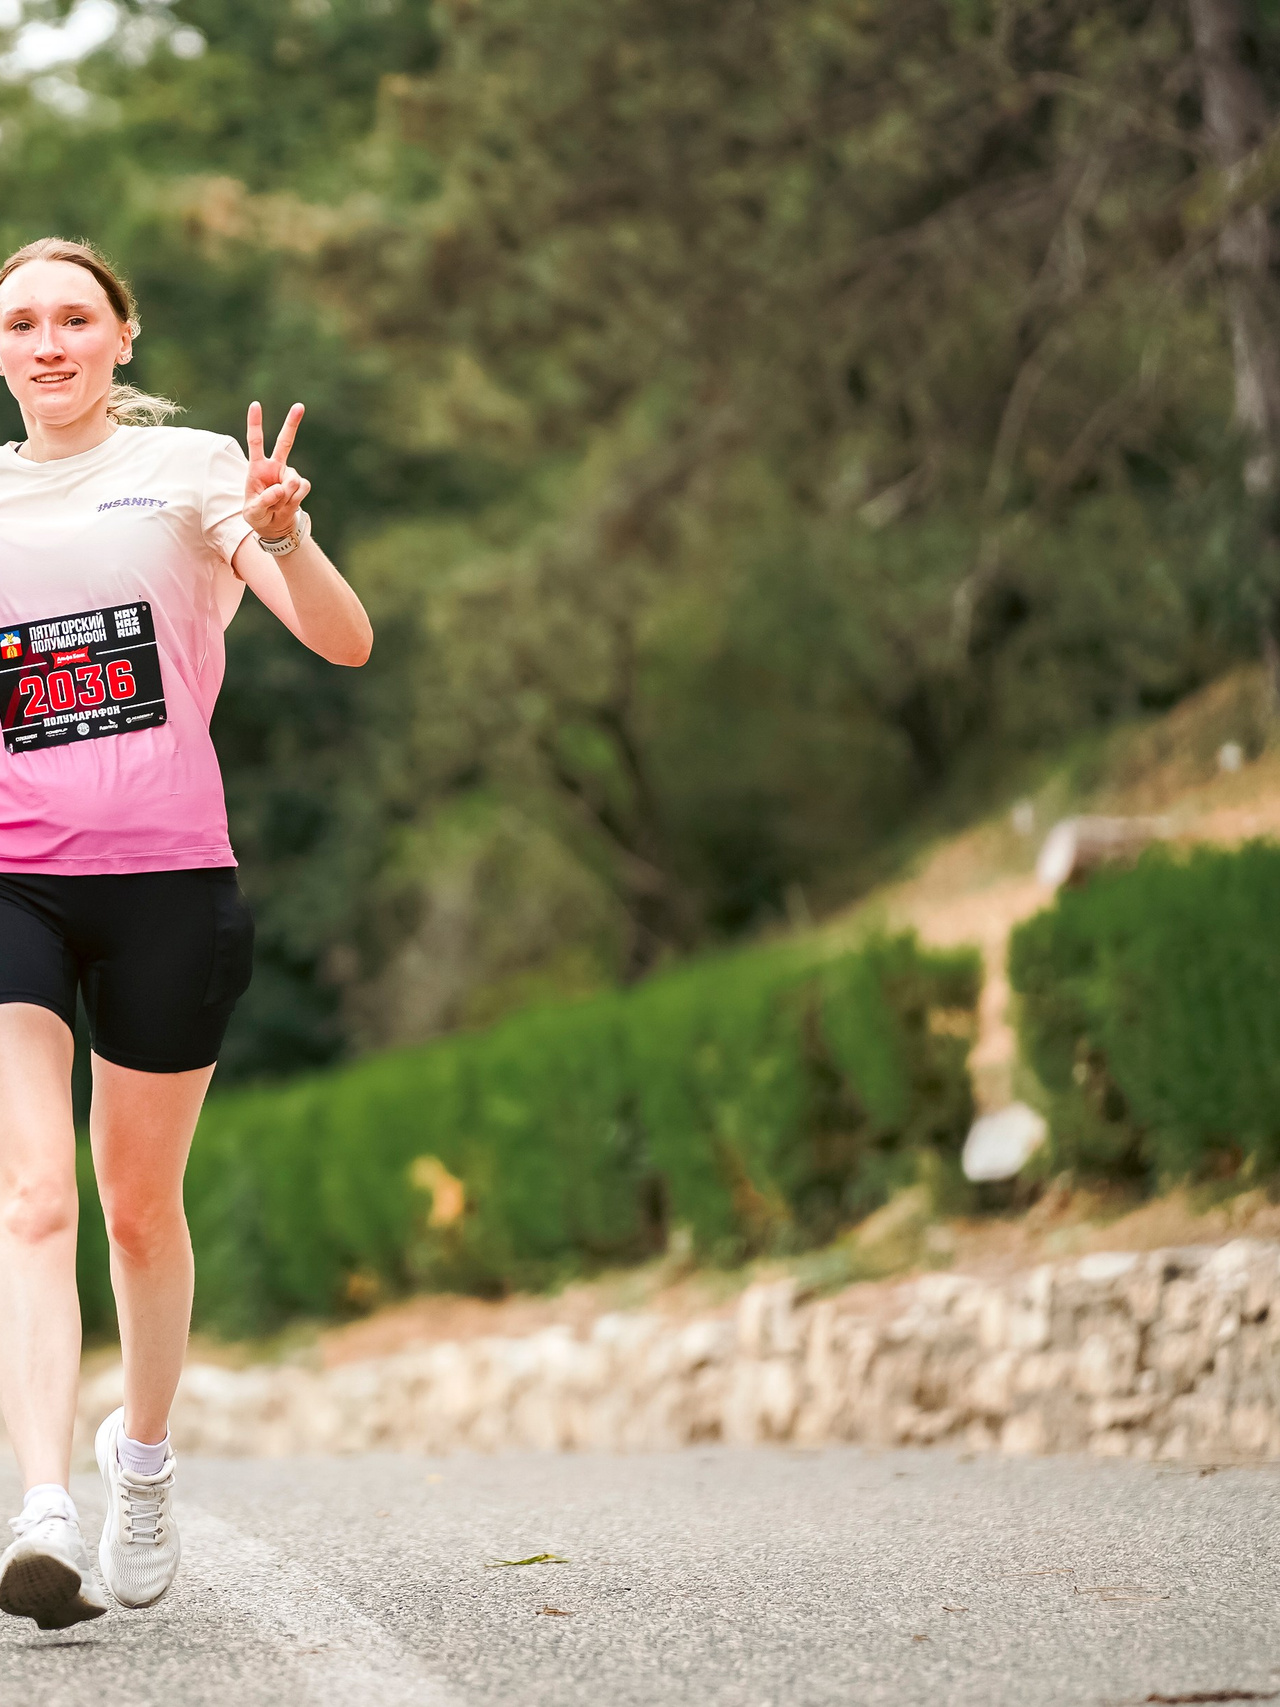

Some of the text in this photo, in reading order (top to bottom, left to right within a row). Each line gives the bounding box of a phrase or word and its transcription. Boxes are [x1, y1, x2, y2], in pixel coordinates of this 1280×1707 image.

[96, 497, 168, 512] INSANITY
[29, 612, 105, 641] ПЯТИГОРСКИЙ
[117, 625, 142, 638] RUN
[31, 628, 108, 654] ПОЛУМАРАФОН
[19, 659, 137, 718] 2036
[43, 705, 121, 727] ПОЛУМАРАФОН
